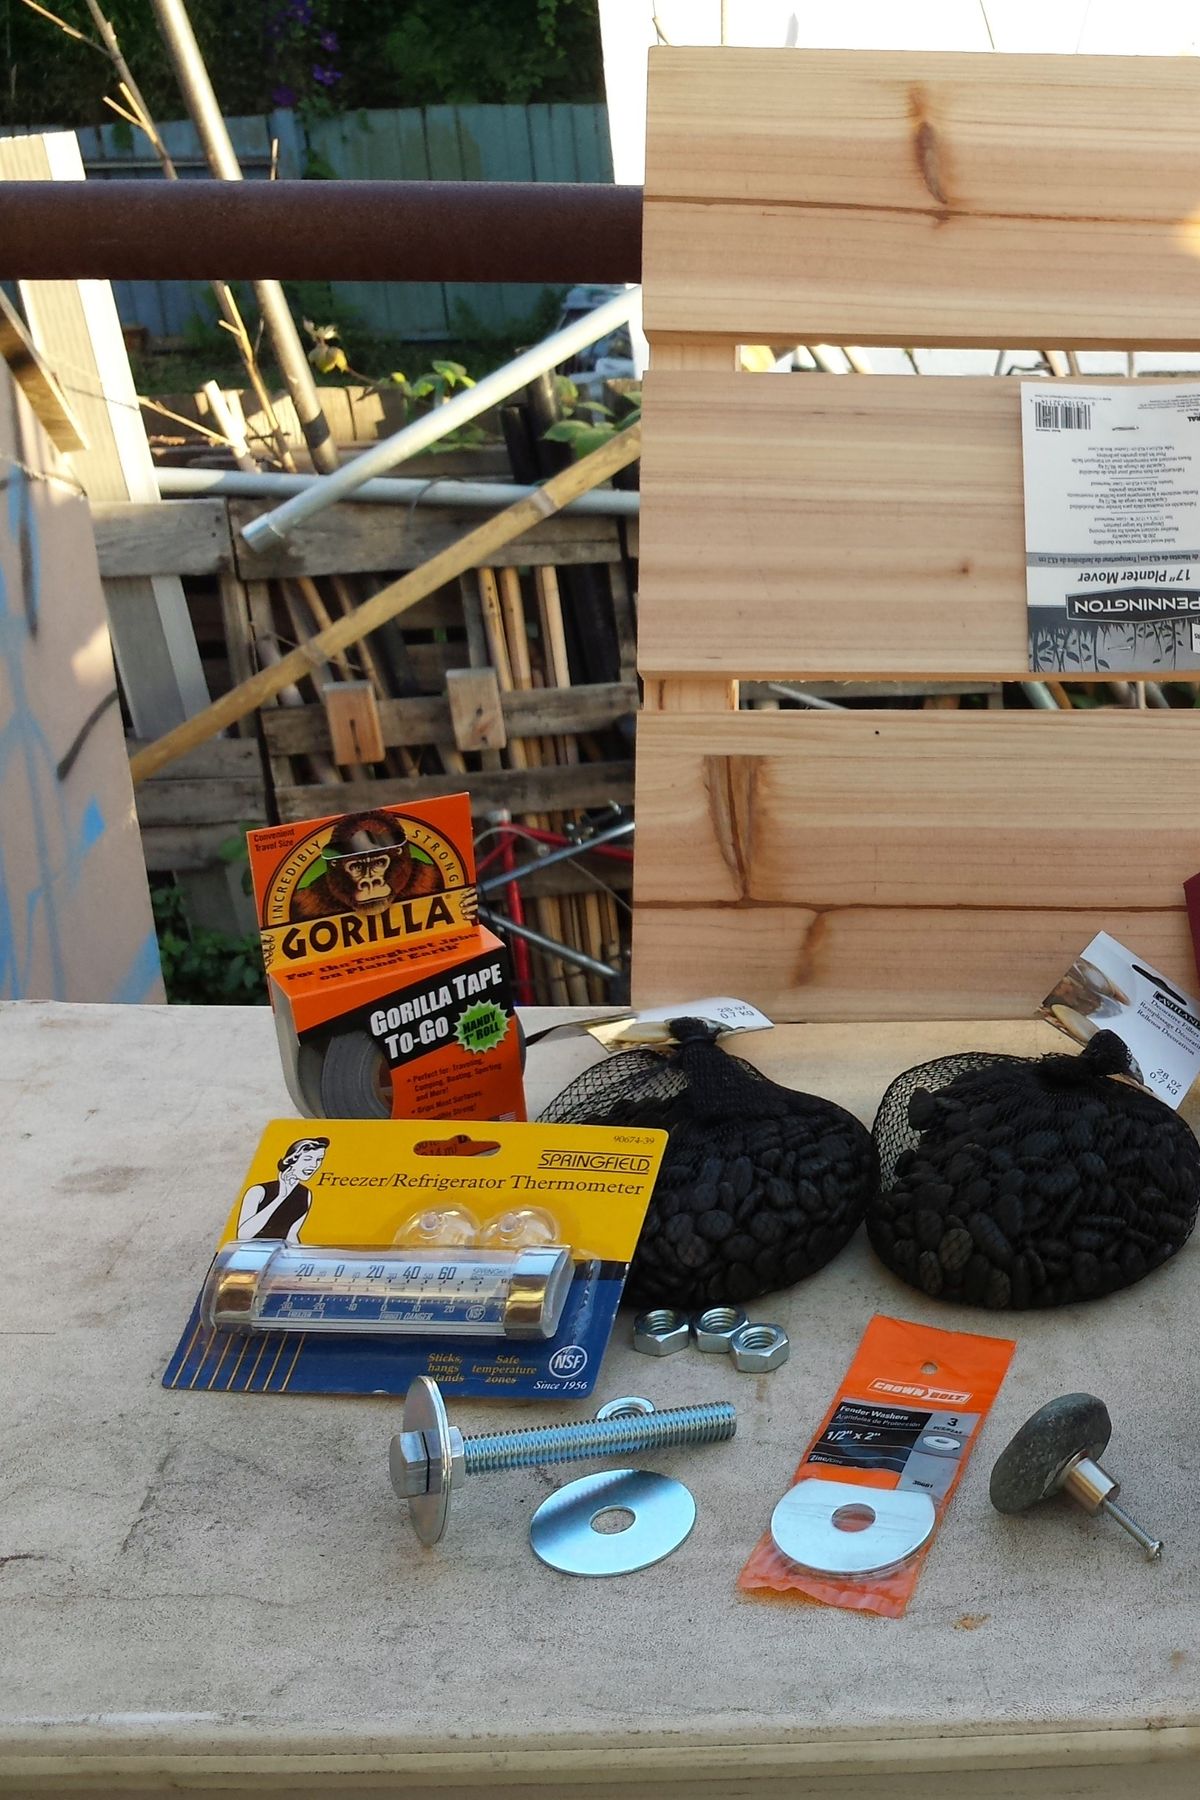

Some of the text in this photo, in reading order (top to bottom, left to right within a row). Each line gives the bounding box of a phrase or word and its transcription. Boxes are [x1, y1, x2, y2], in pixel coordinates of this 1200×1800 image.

[1078, 571, 1119, 584] Mover
[1121, 570, 1167, 584] Planter
[253, 828, 295, 843] Convenient
[255, 838, 294, 852] Travel Size
[272, 829, 459, 919] INCREDIBLY STRONG
[282, 896, 455, 960] GORILLA
[285, 932, 480, 981] For the Toughest Jobs
[319, 968, 344, 981] on
[347, 956, 402, 975] Planet
[370, 963, 503, 1037] GORILLA TAPE
[740, 1009, 755, 1018] kg
[1151, 1000, 1200, 1038] Decorative Fillers
[462, 1010, 496, 1034] HANDY
[384, 1016, 449, 1060] TO-GO
[475, 1021, 500, 1040] ROLL
[1162, 1028, 1195, 1055] Decorativos
[413, 1069, 438, 1082] Perfect
[474, 1063, 502, 1076] Sporting
[1149, 1072, 1178, 1095] 0.7 kg
[1156, 1068, 1182, 1089] 28 oz
[613, 1134, 655, 1146] 90674-39
[539, 1152, 651, 1173] SPRINGFIELD
[317, 1172, 644, 1196] Freezer/Refrigerator Thermometer
[335, 1264, 345, 1278] 0
[366, 1265, 384, 1279] 20
[403, 1266, 421, 1280] 40
[438, 1266, 456, 1280] 60
[403, 1312, 434, 1321] DANGER
[468, 1307, 484, 1319] NSF
[444, 1305, 455, 1313] 20
[495, 1354, 519, 1364] Safe
[554, 1353, 583, 1370] NSF
[428, 1363, 459, 1374] hangs
[472, 1364, 537, 1375] temperature
[432, 1373, 465, 1383] tands
[485, 1375, 517, 1384] zones
[533, 1380, 587, 1390] Since 1956
[873, 1381, 925, 1397] CROWN
[836, 1413, 871, 1424] Arandelas
[872, 1417, 882, 1425] de
[840, 1405, 909, 1421] Fender Washers
[947, 1417, 959, 1427] 3
[826, 1430, 881, 1441] 1/2" x 2"
